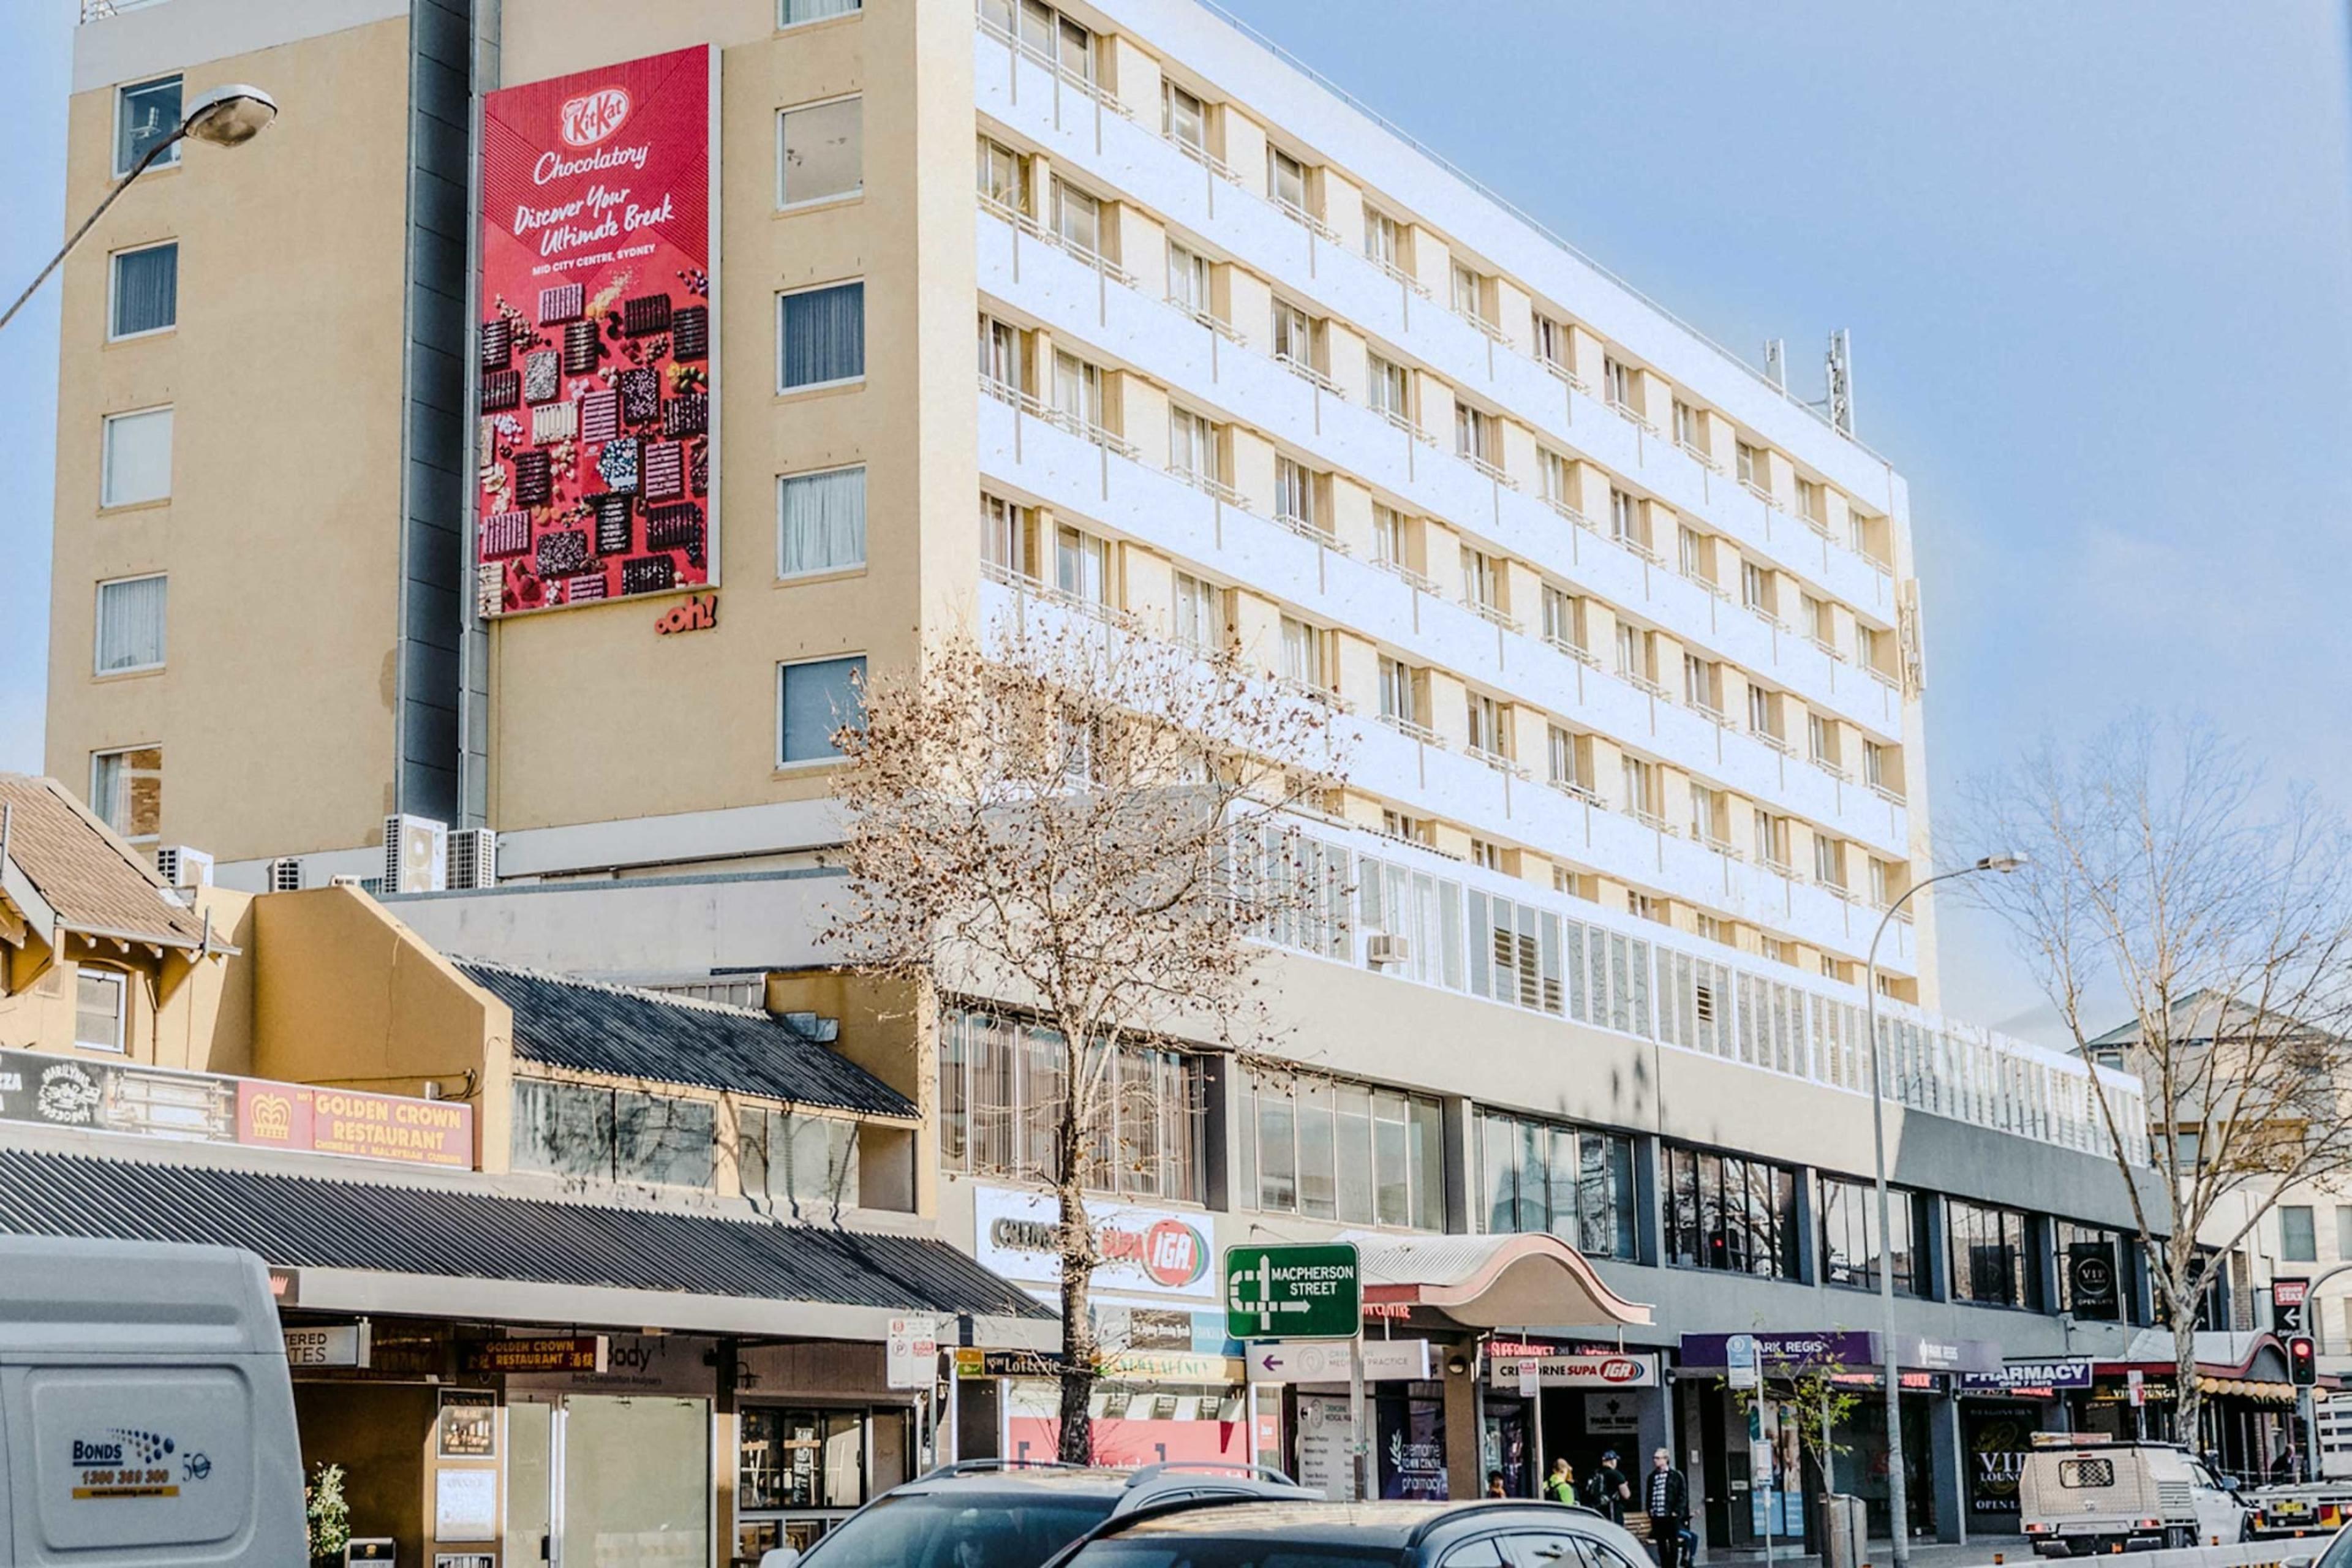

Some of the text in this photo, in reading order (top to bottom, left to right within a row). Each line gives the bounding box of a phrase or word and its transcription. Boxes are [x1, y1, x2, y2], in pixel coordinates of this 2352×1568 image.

[570, 94, 623, 142] KitKat
[533, 146, 649, 185] Chocolatory
[513, 185, 630, 235] Discover Your
[540, 192, 674, 256] Ultimate Break
[532, 265, 552, 276] MID
[552, 259, 575, 273] CITY
[617, 243, 656, 260] SYDNEY
[315, 1094, 461, 1129] GOLDEN CROWN
[333, 1120, 444, 1150] RESTAURANT
[1152, 1231, 1191, 1270] IGA
[1271, 1265, 1354, 1281] MACPHERSON
[1290, 1281, 1337, 1296] STREET
[486, 1340, 575, 1353] GOLDEN CROWN
[1785, 1341, 1823, 1353] REGIS
[496, 1353, 564, 1366] RESTAURANT
[1005, 1357, 1062, 1373] Lotterie
[1567, 1365, 1597, 1376] SUPA
[1604, 1363, 1632, 1378] IGA
[73, 1440, 123, 1460] BONDS
[82, 1470, 115, 1485] 1300
[1980, 1471, 2022, 1482] LOUN
[1976, 1501, 2008, 1510] OPEN
